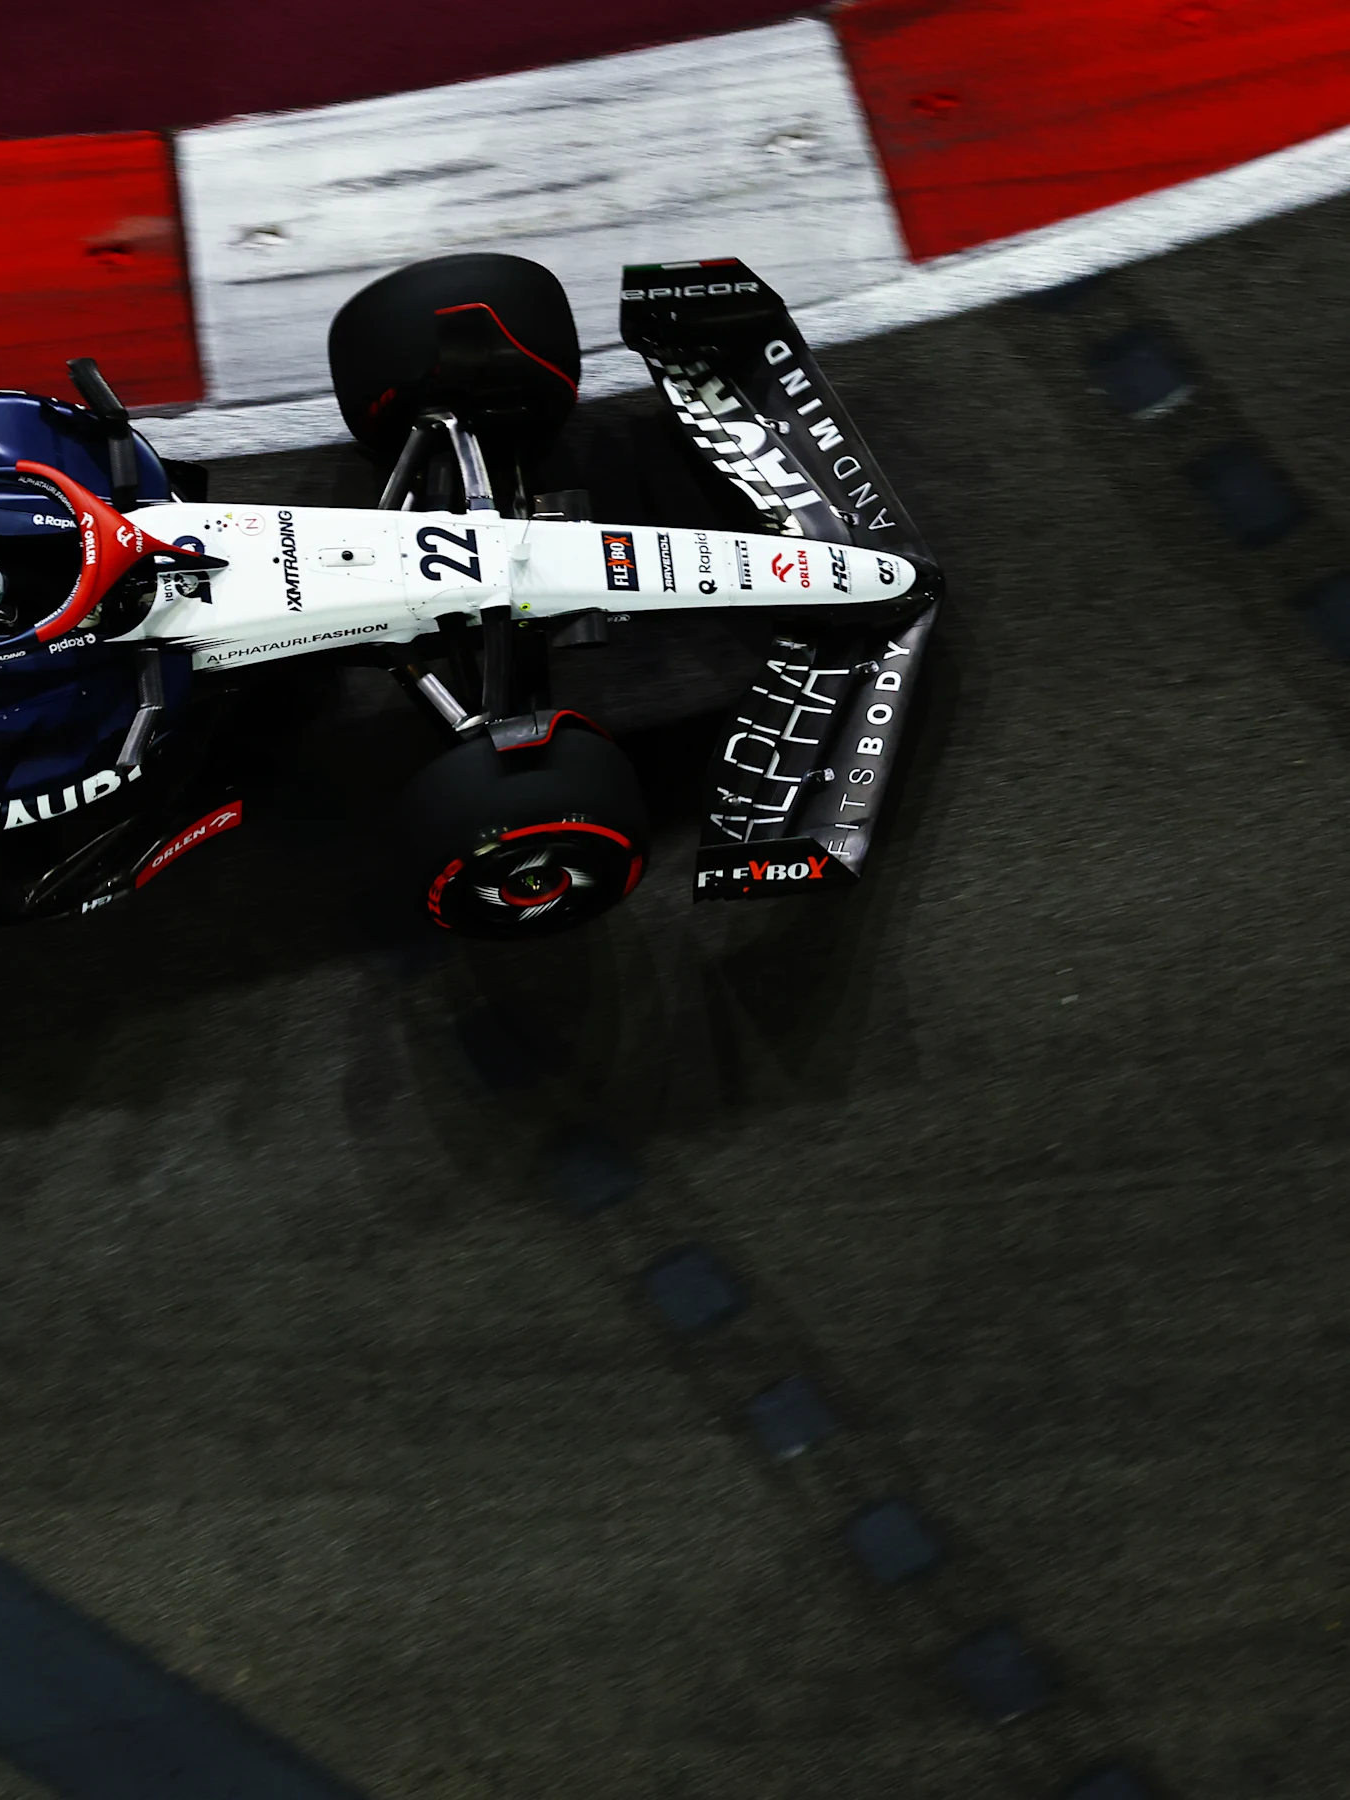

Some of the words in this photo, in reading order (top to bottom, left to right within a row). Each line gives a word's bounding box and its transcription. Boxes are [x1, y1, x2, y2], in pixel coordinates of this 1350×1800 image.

[763, 338, 845, 453] MIND
[832, 455, 897, 531] AND
[83, 529, 97, 566] ORLEN
[278, 510, 302, 612] XMTRADING
[417, 526, 482, 583] 22
[604, 534, 634, 586] FLEXBOX
[660, 535, 674, 588] RAVENOL
[694, 532, 712, 573] Rapid
[735, 540, 753, 590] PIRELLI
[797, 550, 811, 588] ORLEN
[827, 546, 848, 593] HRC
[48, 634, 85, 654] Rapid
[206, 622, 390, 664] ALPHATAURI.FASHION
[856, 641, 911, 756] BODY
[152, 825, 206, 868] ORLEN
